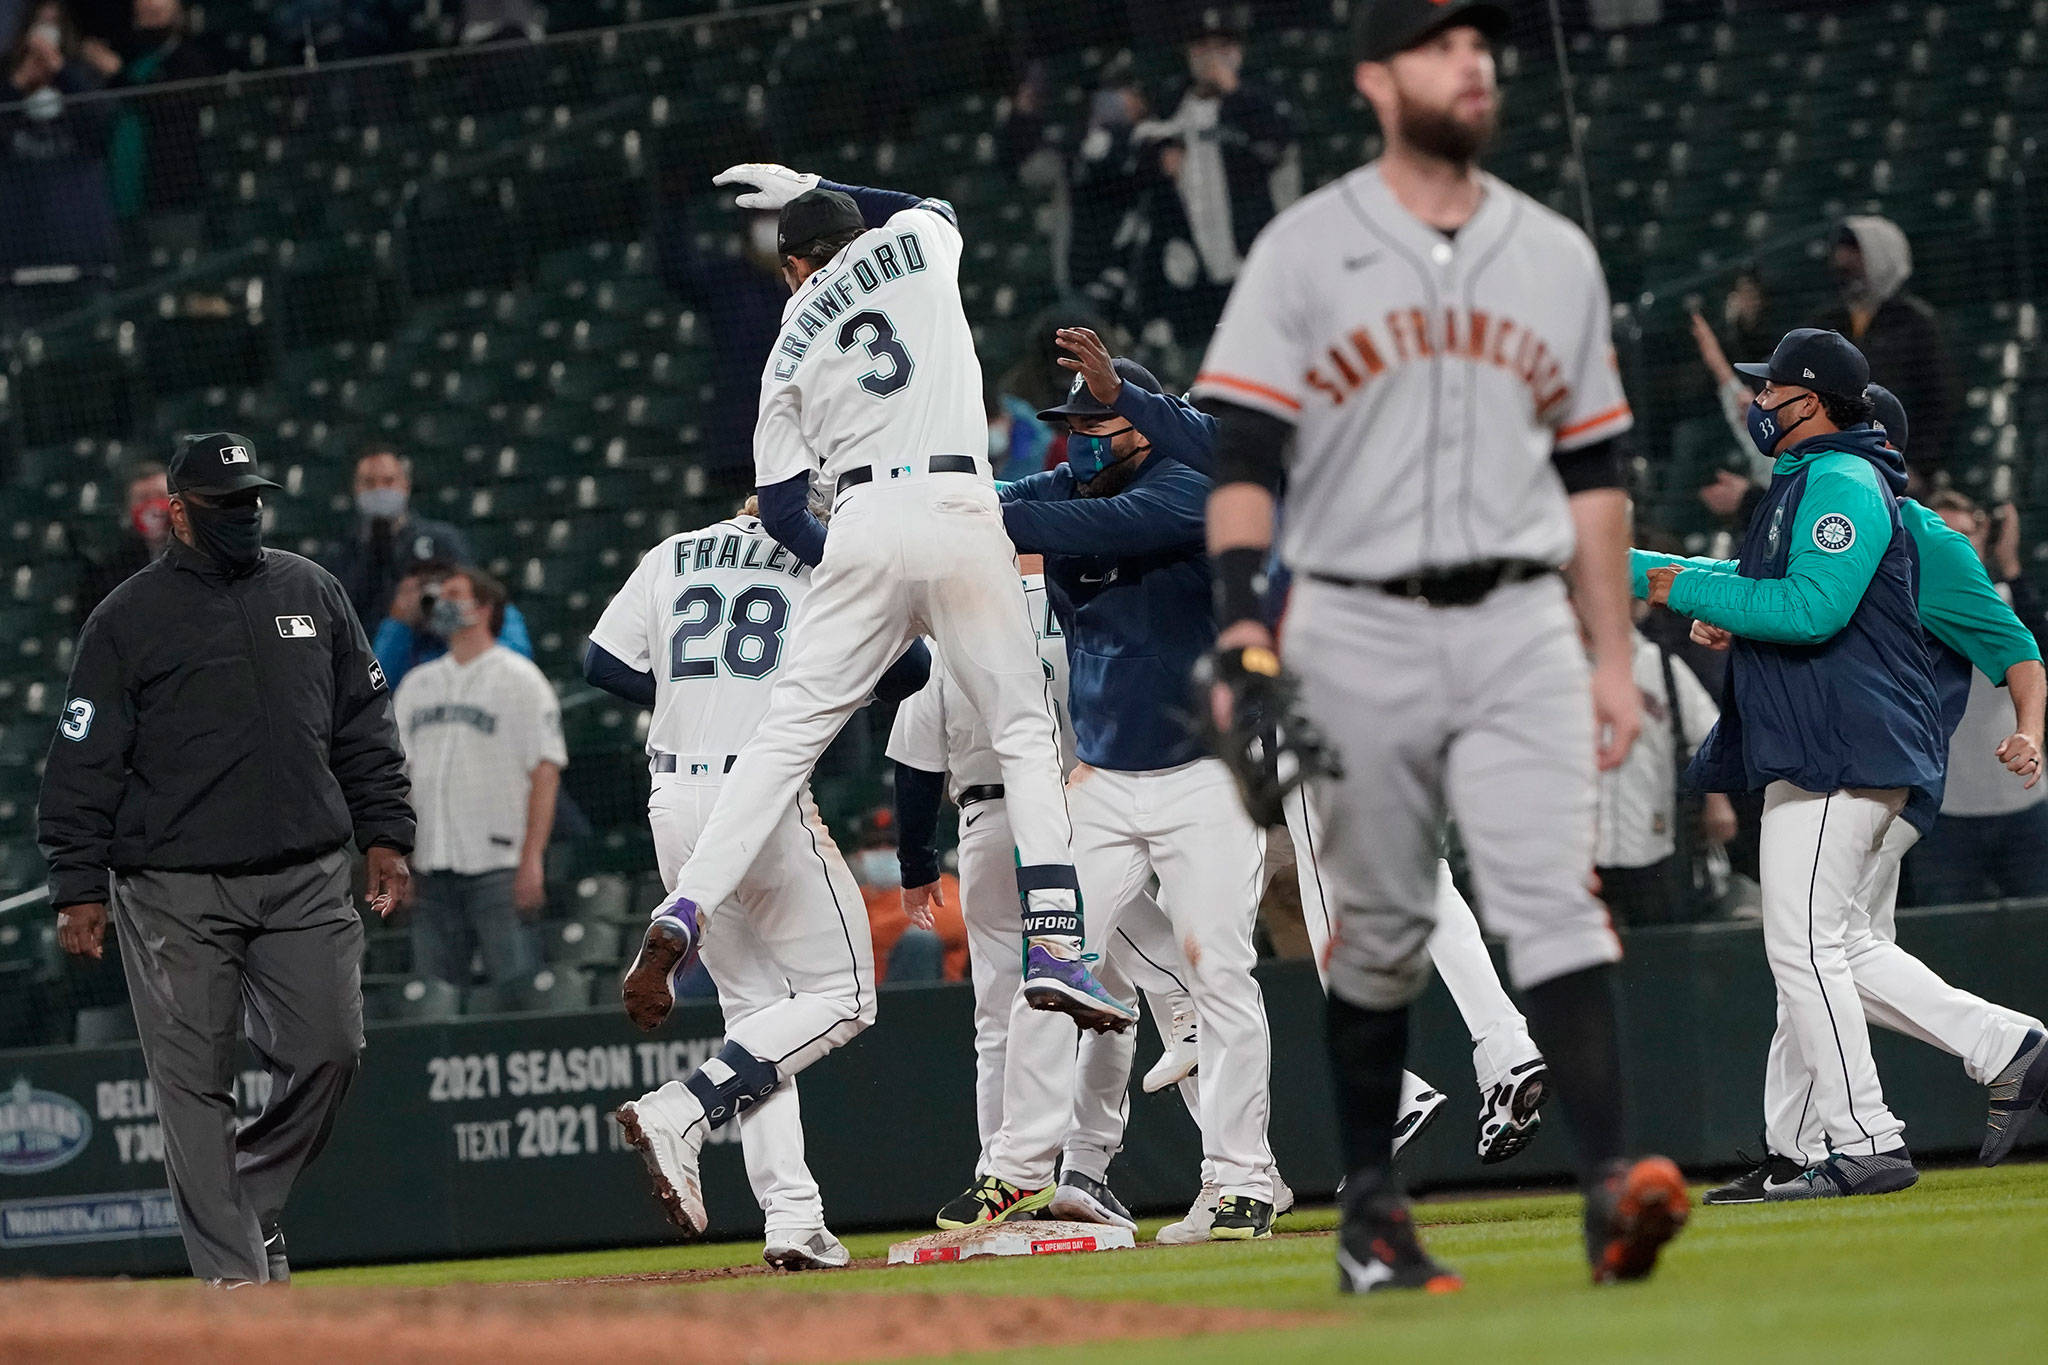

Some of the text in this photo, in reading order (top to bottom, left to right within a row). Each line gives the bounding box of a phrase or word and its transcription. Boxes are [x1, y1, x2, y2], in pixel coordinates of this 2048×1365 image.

[774, 231, 928, 383] CRAWFORD
[835, 308, 916, 399] 3
[1305, 306, 1571, 422] SAN FRANCISCO
[1759, 417, 1775, 440] 33
[670, 583, 791, 682] 28
[60, 696, 96, 742] 3
[96, 1077, 158, 1121] DELI
[427, 1036, 722, 1101] 2021 SEASON TICK
[453, 1118, 512, 1162] TEXT
[515, 1103, 599, 1159] 2021
[1072, 1240, 1084, 1249] DAY
